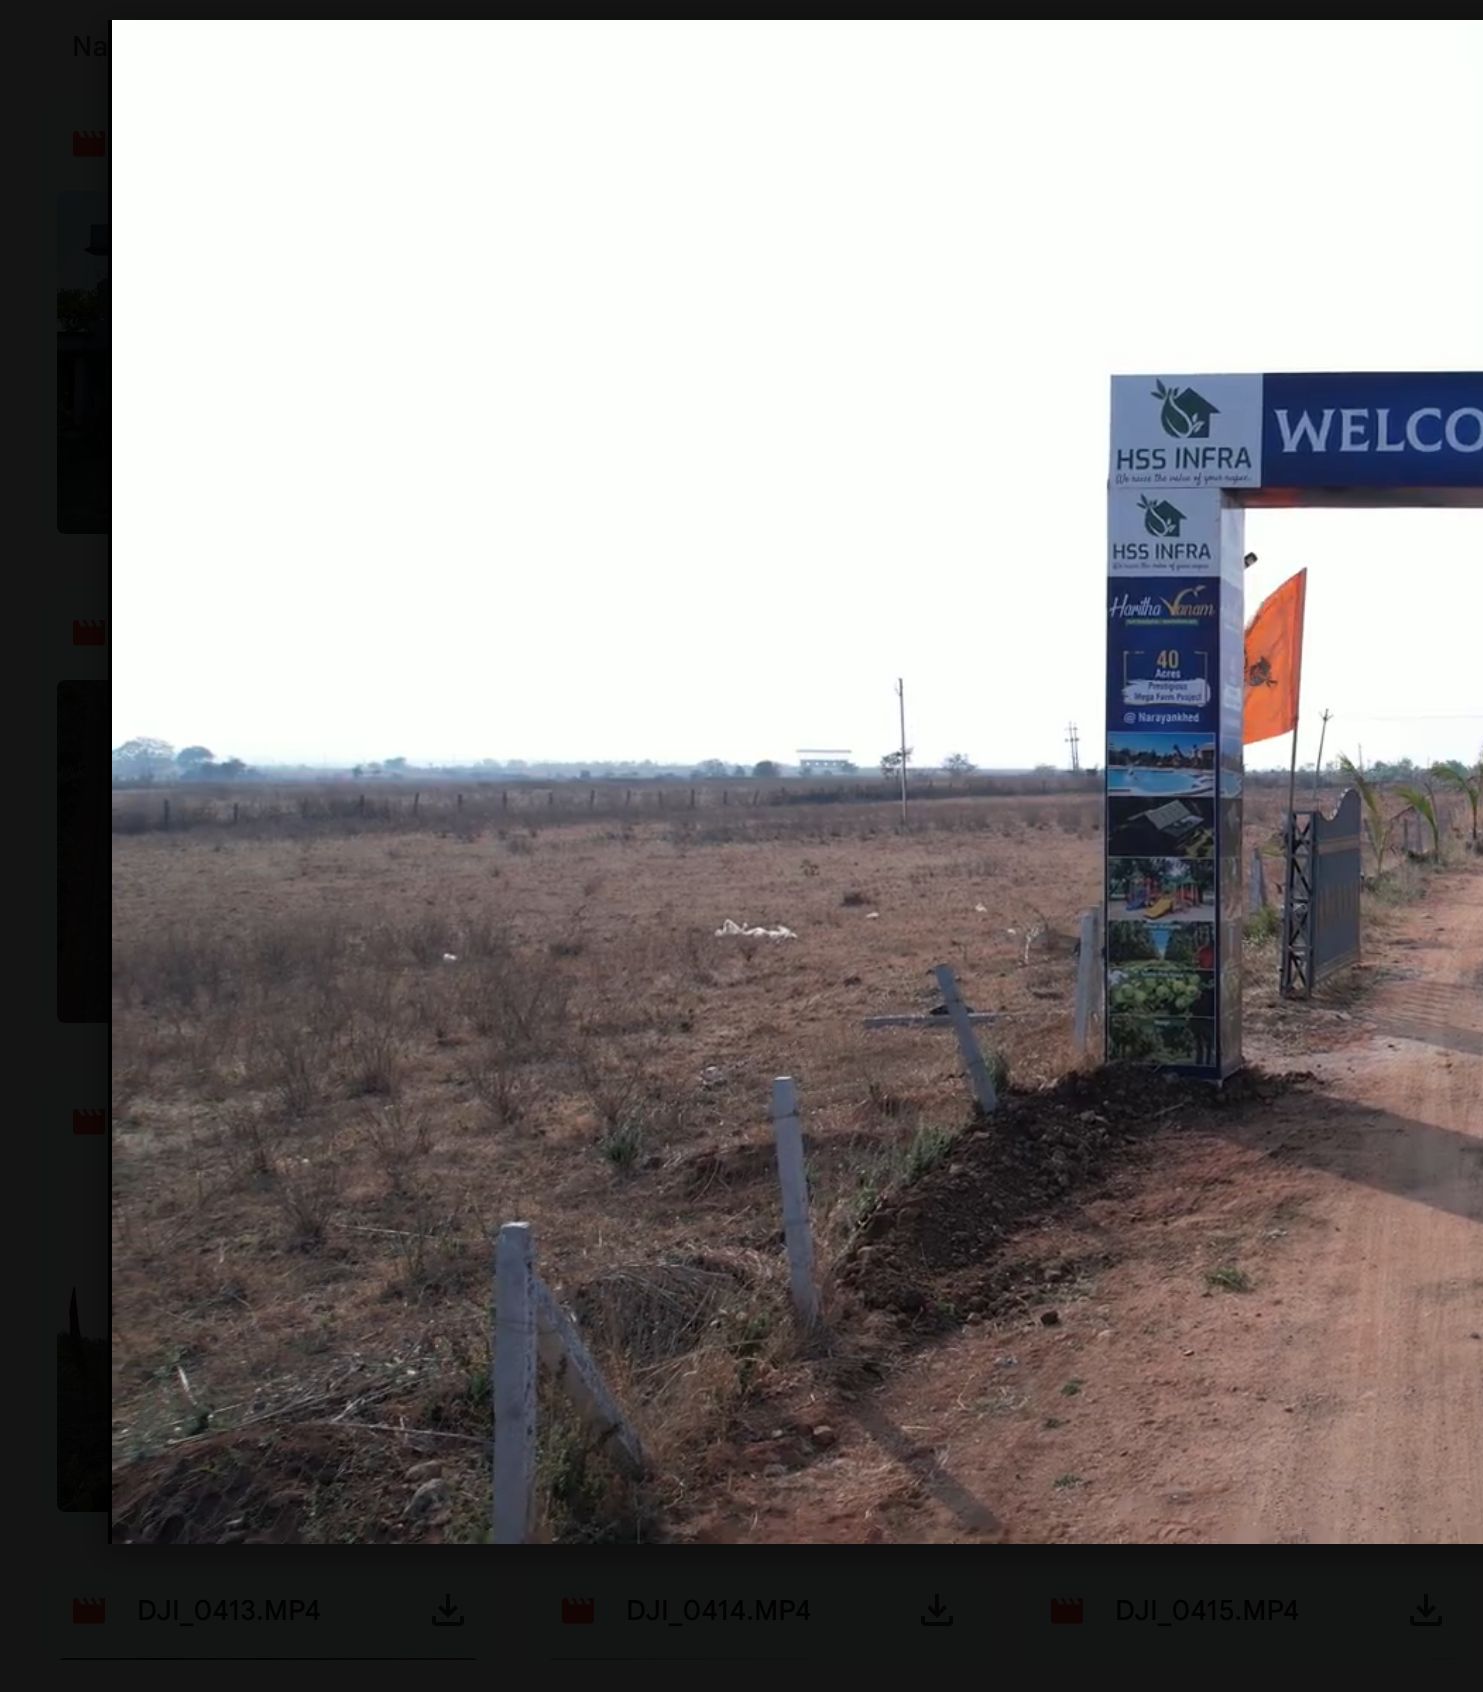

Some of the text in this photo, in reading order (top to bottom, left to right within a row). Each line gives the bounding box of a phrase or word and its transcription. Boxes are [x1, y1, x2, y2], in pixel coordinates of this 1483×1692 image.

[1116, 446, 1252, 470] HSS INFRA
[1113, 543, 1212, 560] HSS INFRA
[1109, 585, 1216, 618] Haritha Vanam
[1156, 649, 1179, 669] 40
[1154, 669, 1181, 679] Acres
[1138, 711, 1200, 725] Narayankhed
[139, 1599, 320, 1627] DJI_0413.MP4
[628, 1599, 810, 1627] DJI_0414.MP4
[1117, 1599, 1298, 1627] DJI_0415.MP4
